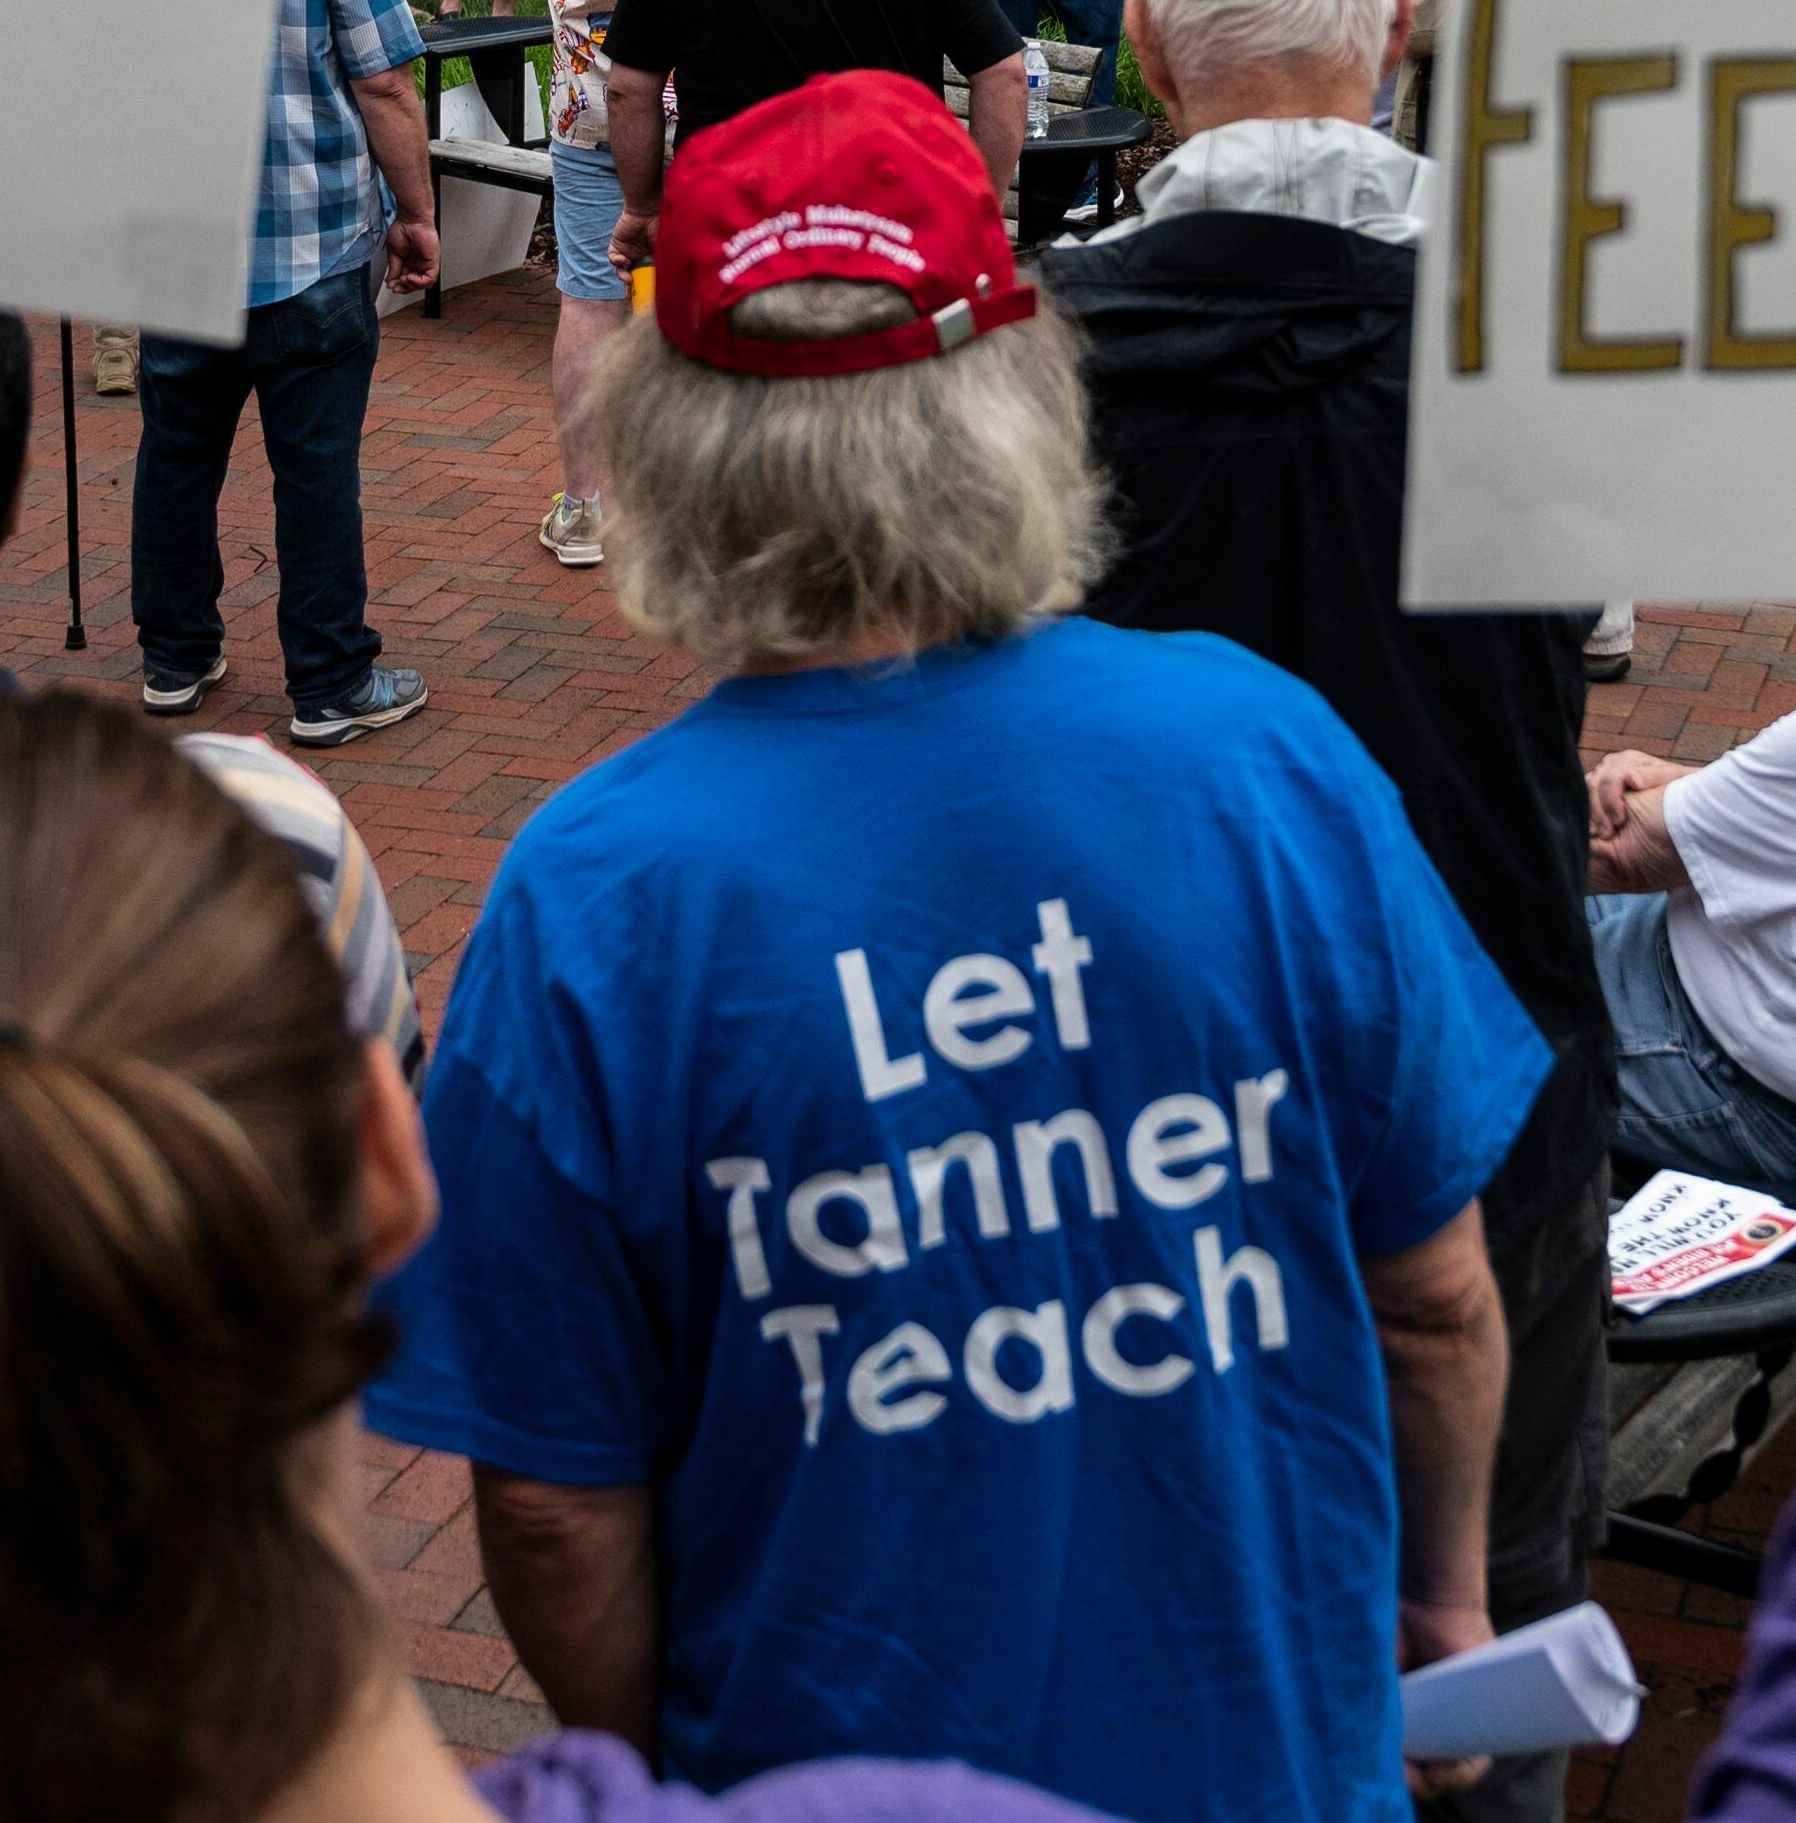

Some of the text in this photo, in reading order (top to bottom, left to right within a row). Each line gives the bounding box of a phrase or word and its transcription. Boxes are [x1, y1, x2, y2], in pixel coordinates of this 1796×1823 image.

[835, 897, 1093, 1103] Let
[706, 1067, 1290, 1301] Tanner
[1619, 1197, 1732, 1254] KNOW THE
[759, 1224, 1291, 1449] Teach
